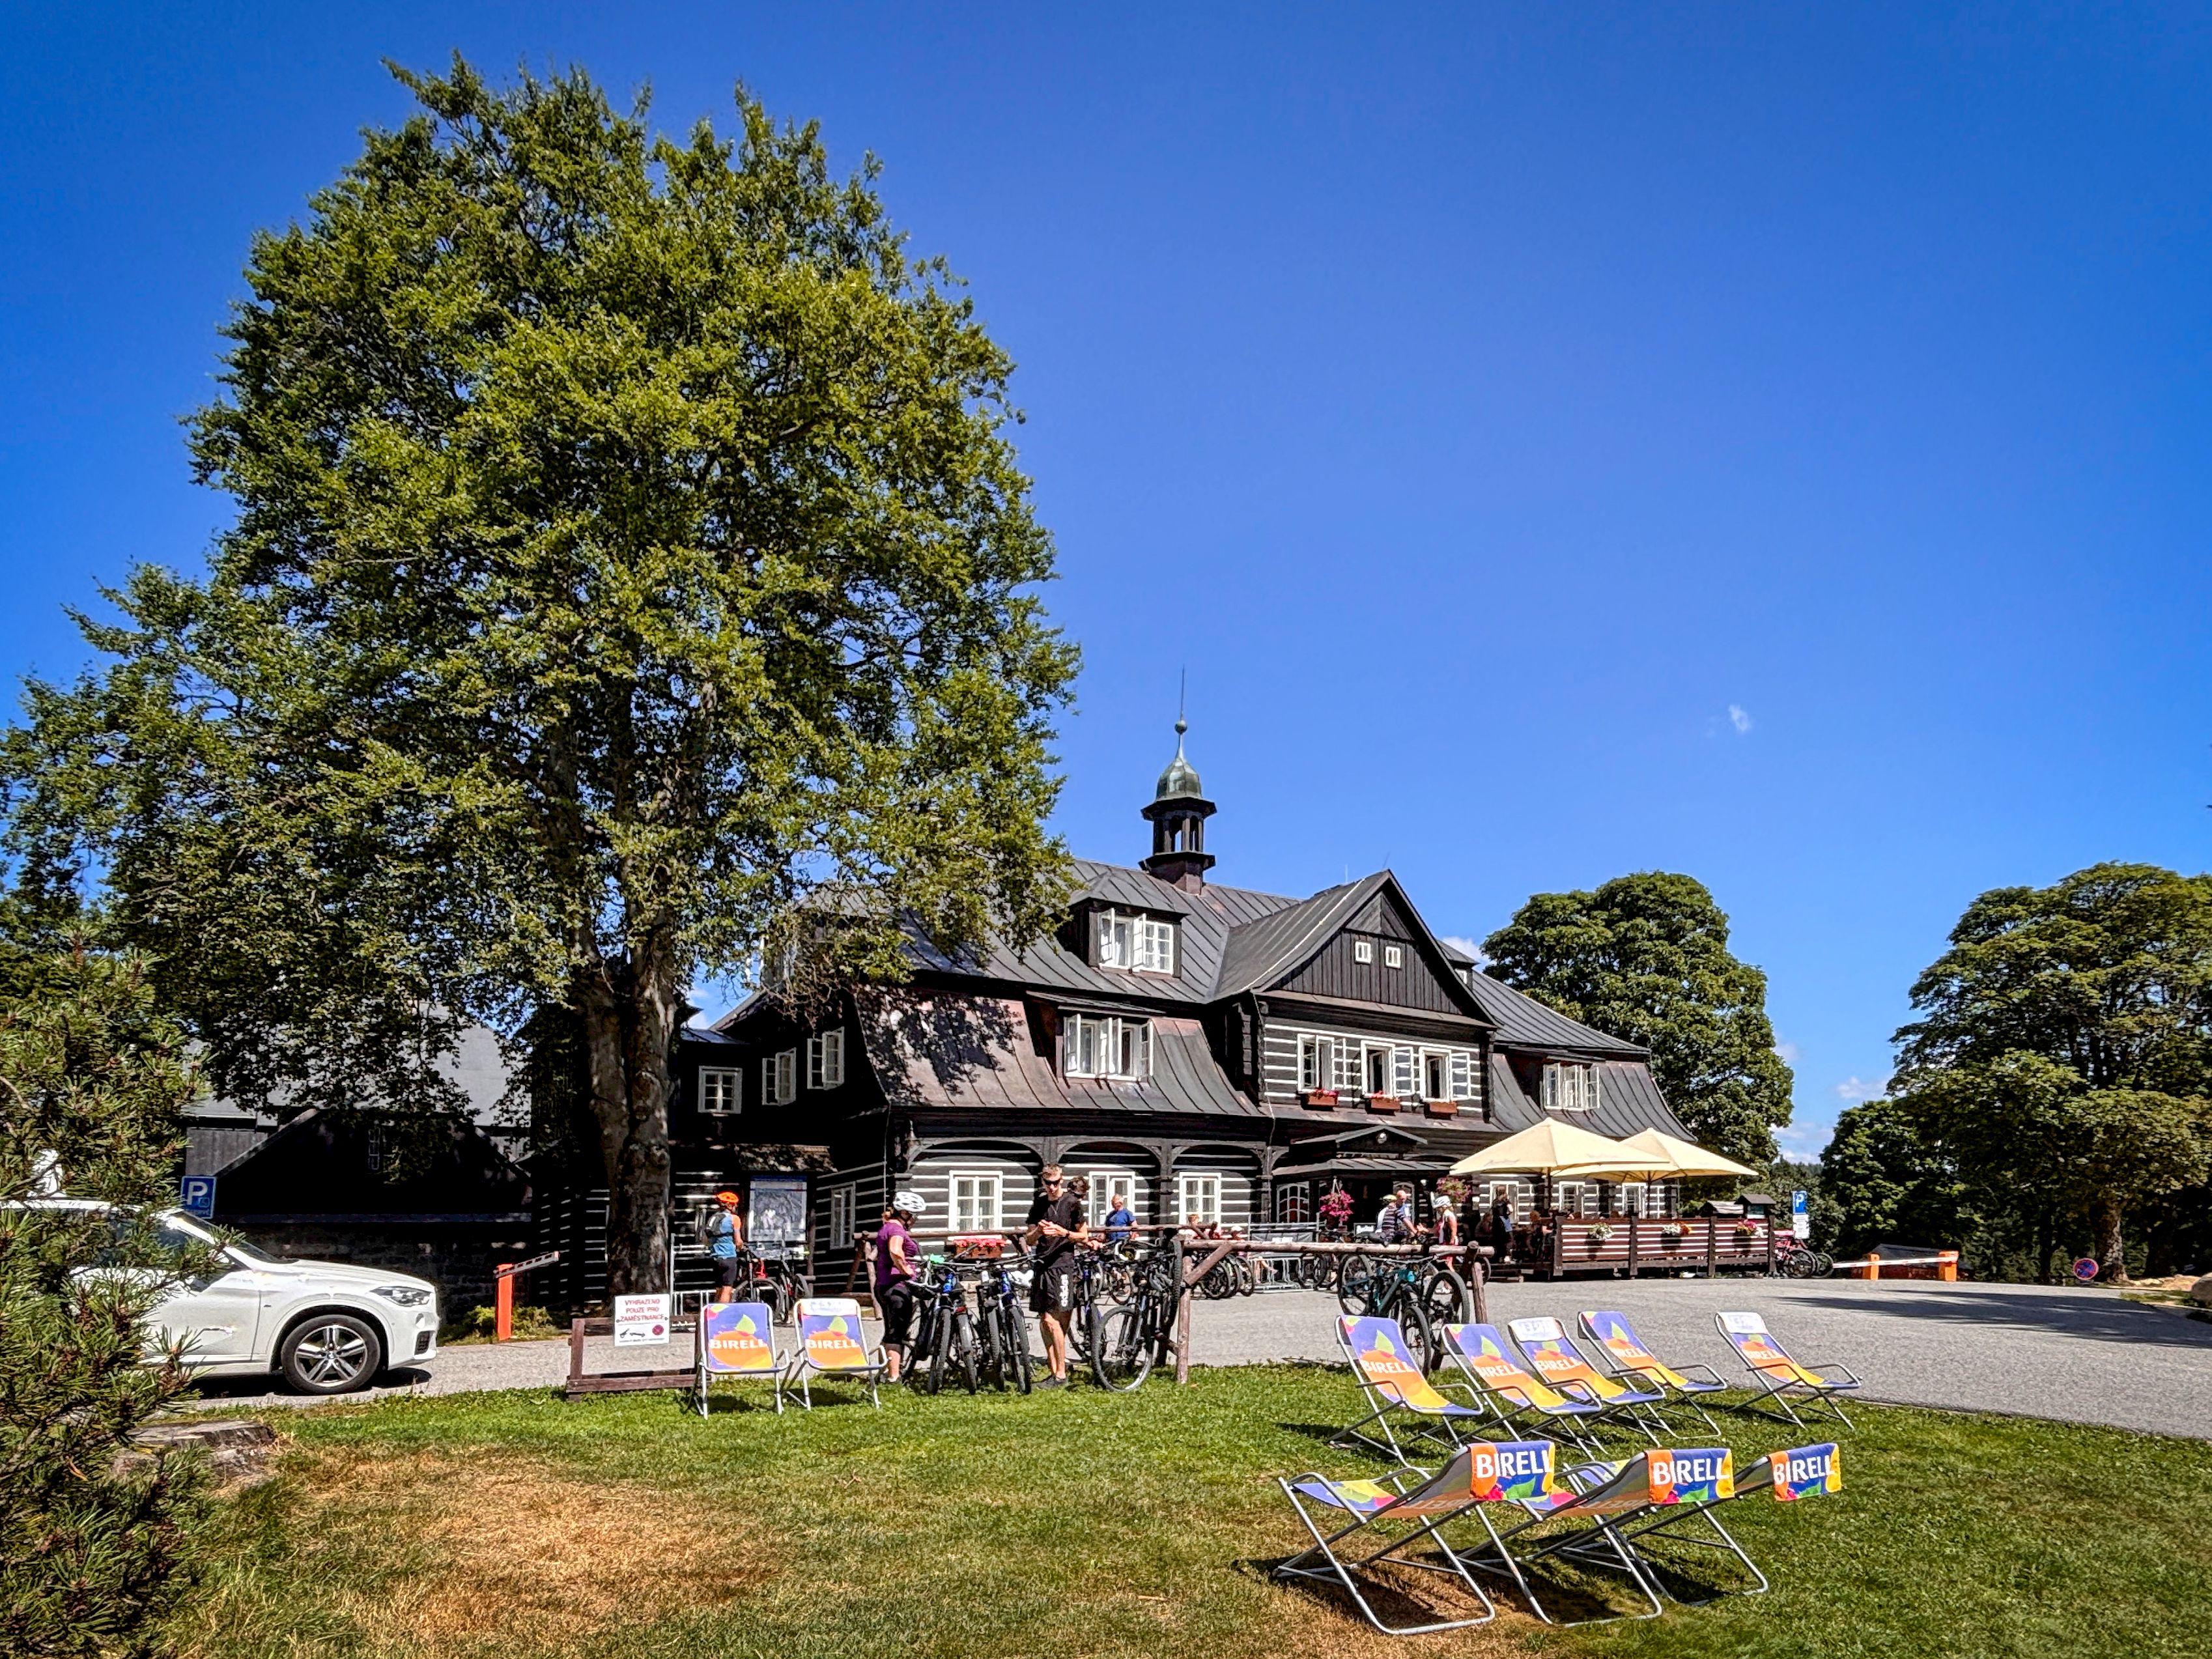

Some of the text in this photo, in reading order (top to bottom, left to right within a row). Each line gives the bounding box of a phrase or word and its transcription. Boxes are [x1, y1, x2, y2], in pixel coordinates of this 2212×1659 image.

[187, 1181, 208, 1205] P
[1795, 1193, 1805, 1208] P
[709, 1339, 769, 1349] BIRELL
[804, 1339, 860, 1349] BIRELL
[1359, 1359, 1415, 1374] BIRELL
[1535, 1356, 1583, 1372] BIRELL
[1475, 1449, 1554, 1479] BIRELL
[1652, 1458, 1731, 1486] BIRELL
[1773, 1454, 1836, 1485] BIRELL
